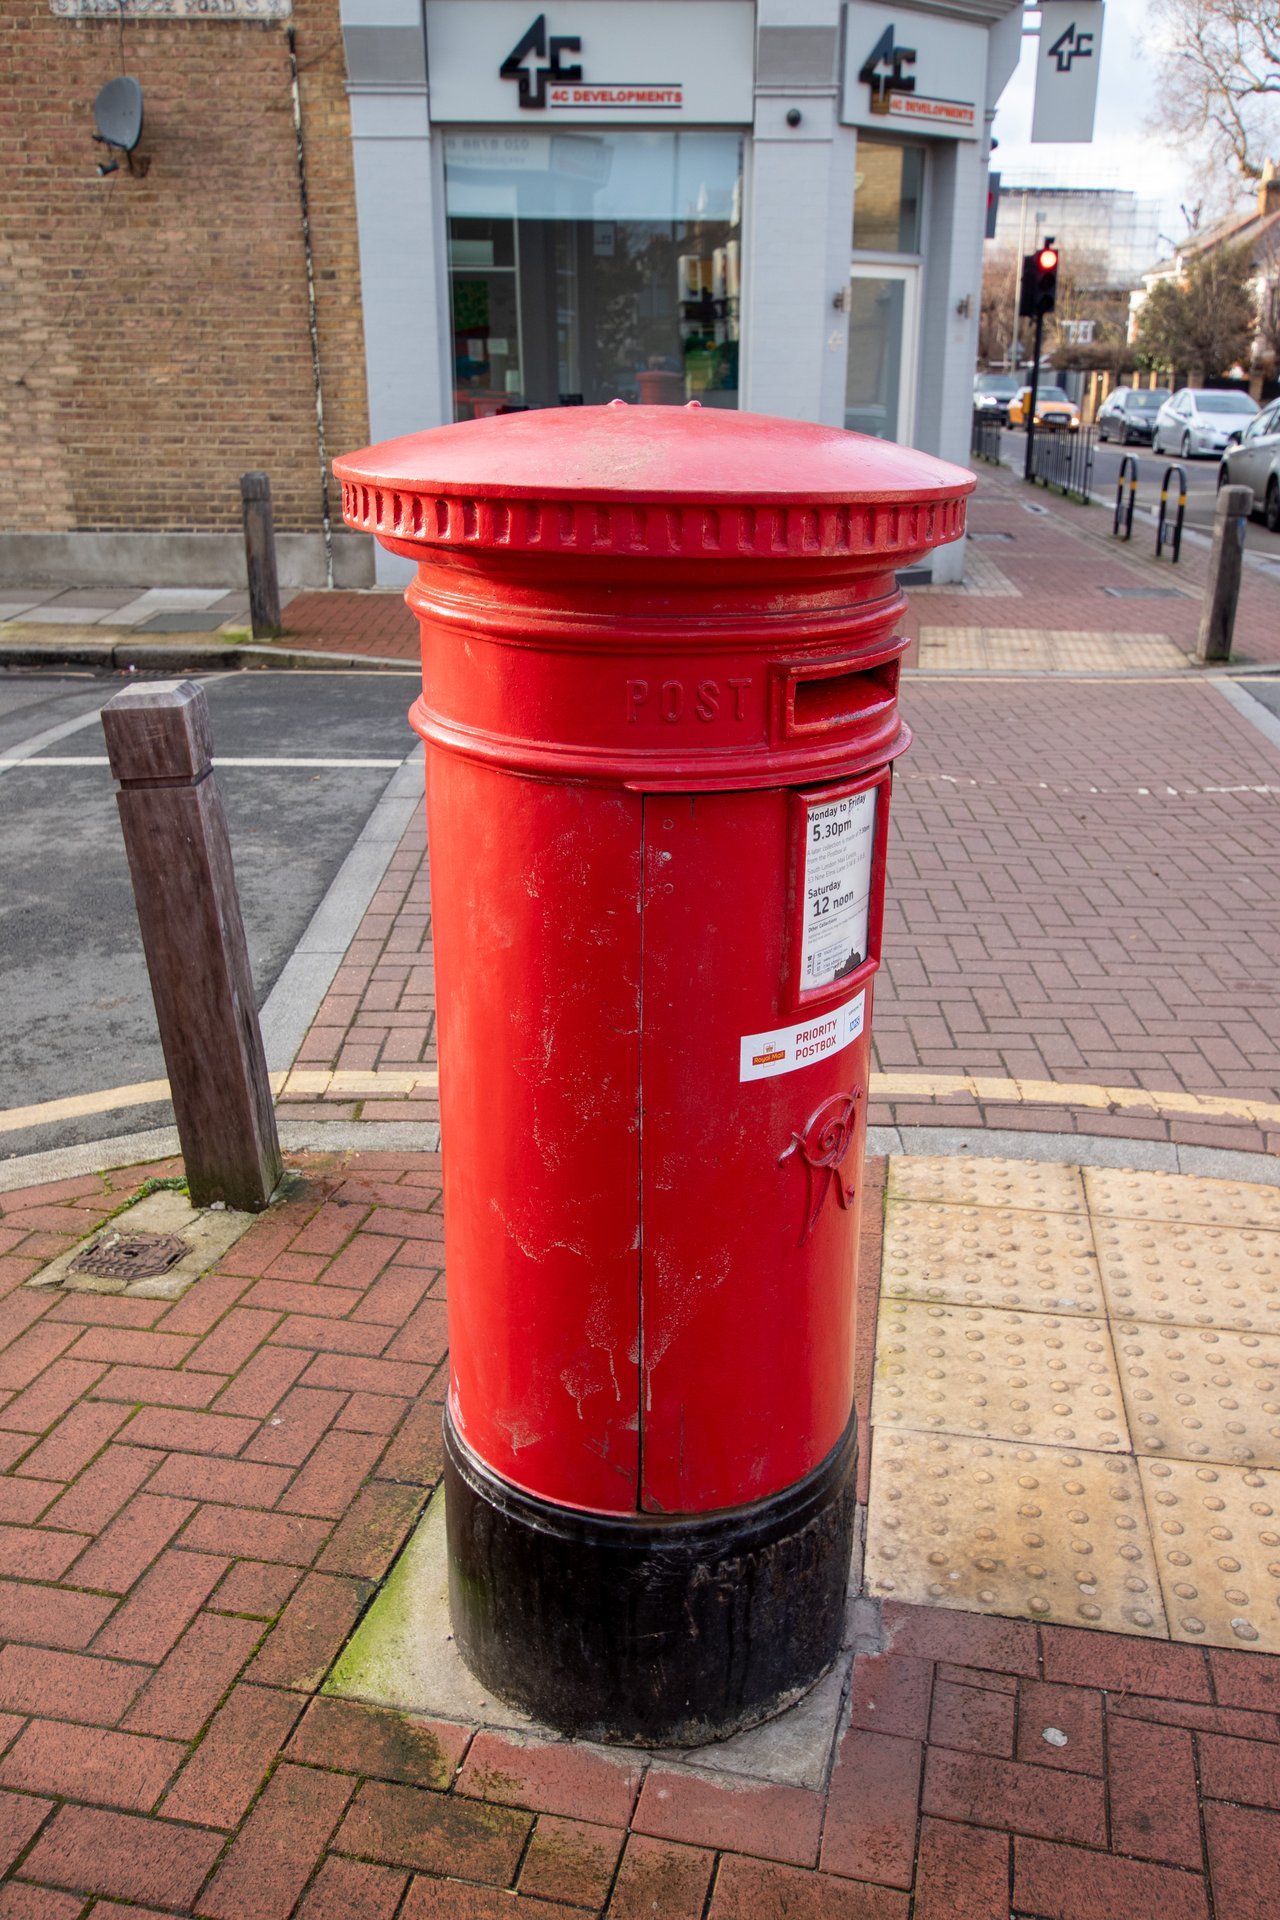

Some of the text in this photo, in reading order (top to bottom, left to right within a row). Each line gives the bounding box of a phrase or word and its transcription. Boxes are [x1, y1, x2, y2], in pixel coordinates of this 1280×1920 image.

[1048, 21, 1093, 72] 4C
[500, 13, 582, 109] 4C
[552, 90, 682, 102] 4C DEVELOPMENTS
[905, 101, 974, 121] DEVELOPMENTS
[626, 678, 752, 722] POST
[808, 794, 867, 823] Monday to Friday
[813, 820, 851, 841] 5.30pm
[808, 880, 841, 899] Saturday
[813, 896, 830, 918] 12
[833, 890, 854, 909] noon
[796, 1019, 837, 1044] PRIORITY
[753, 1051, 785, 1065] Royal Mail
[795, 1034, 837, 1060] POSTBOX
